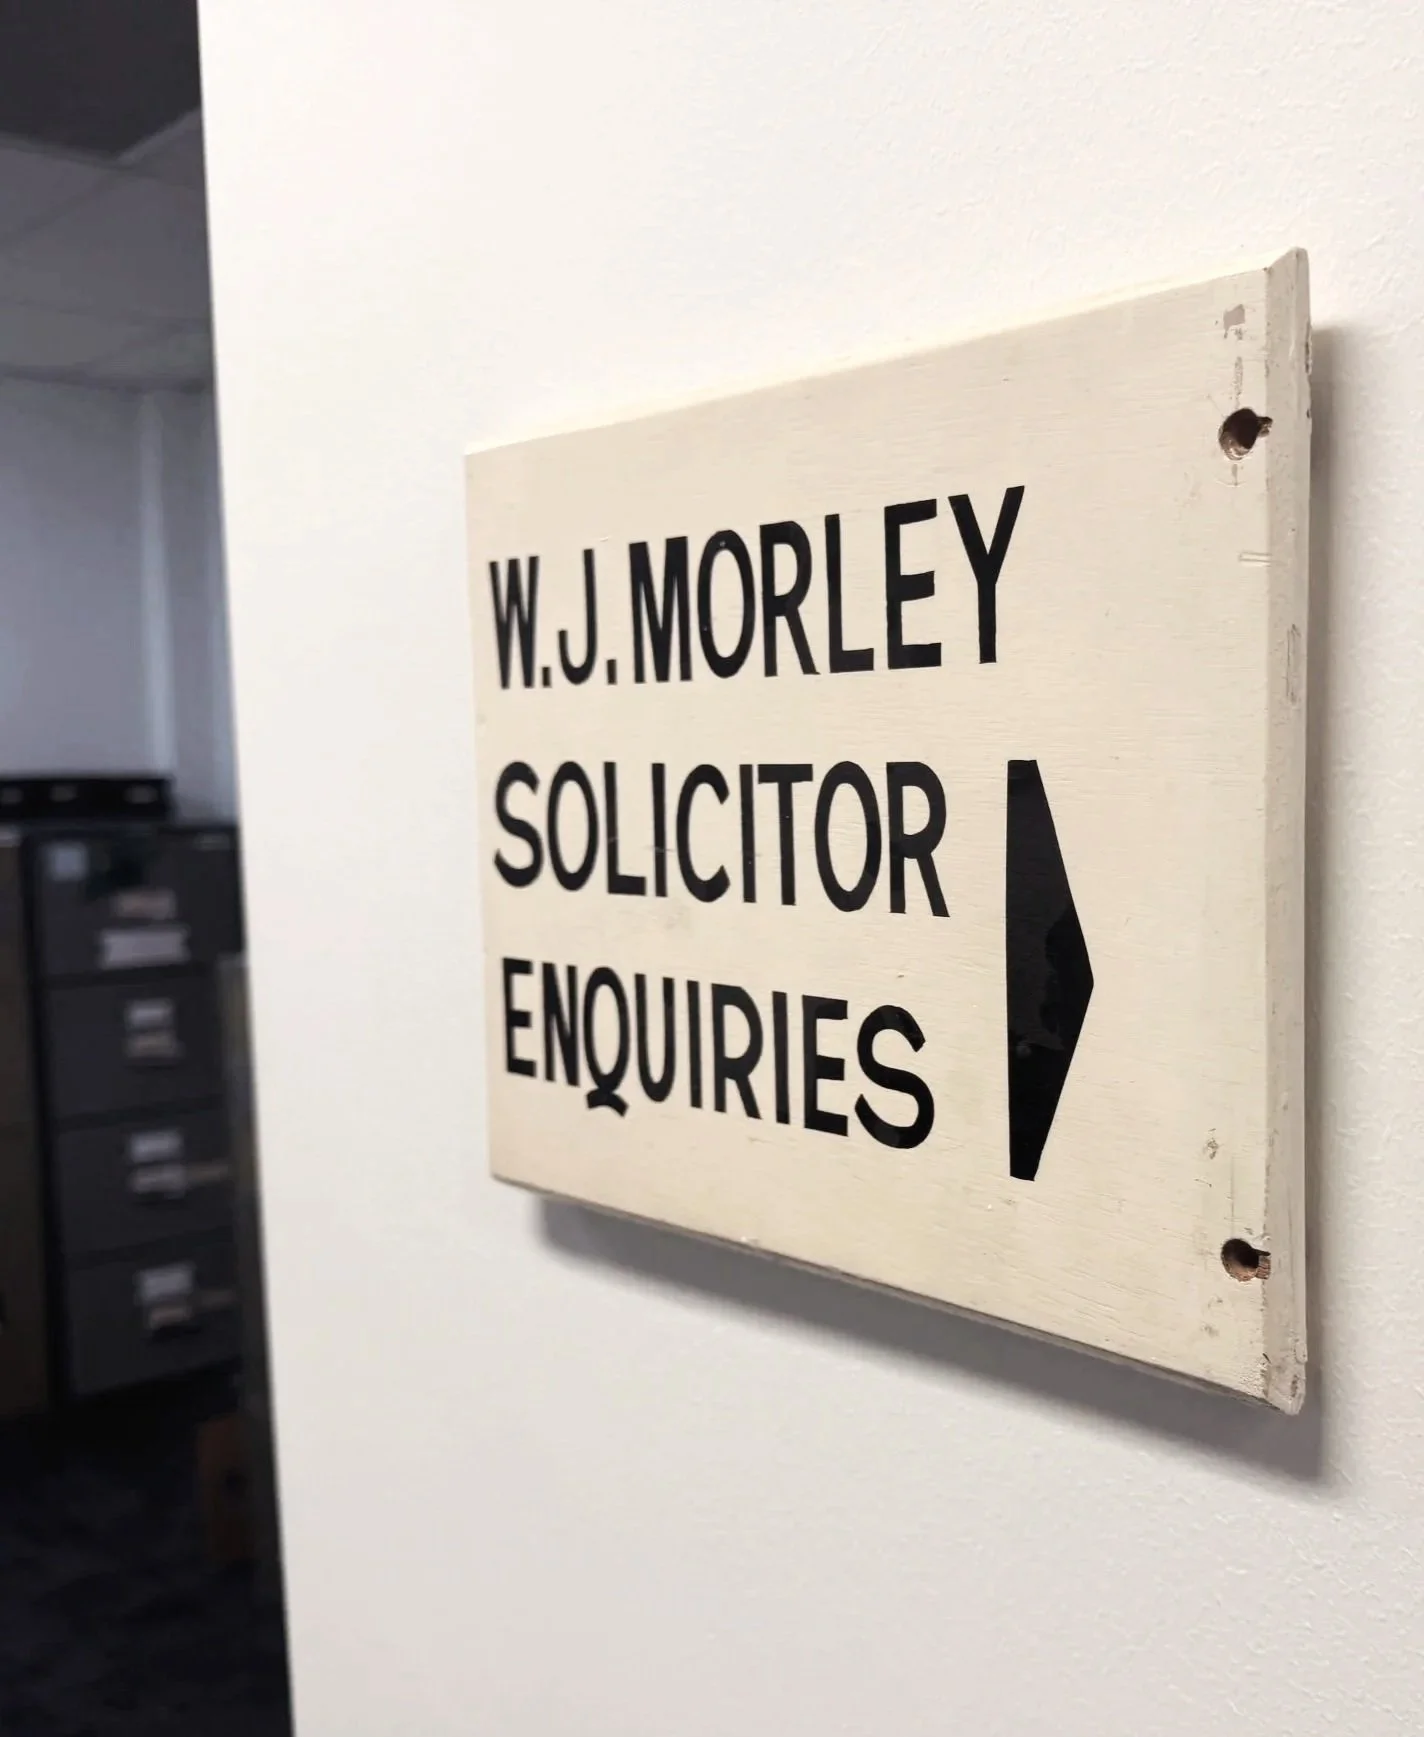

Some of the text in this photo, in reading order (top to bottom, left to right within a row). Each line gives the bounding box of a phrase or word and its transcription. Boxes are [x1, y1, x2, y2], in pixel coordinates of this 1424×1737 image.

[628, 485, 1025, 684] MORLEY
[494, 761, 950, 918] SOLICITOR
[502, 957, 935, 1150] ENQUIRIES
